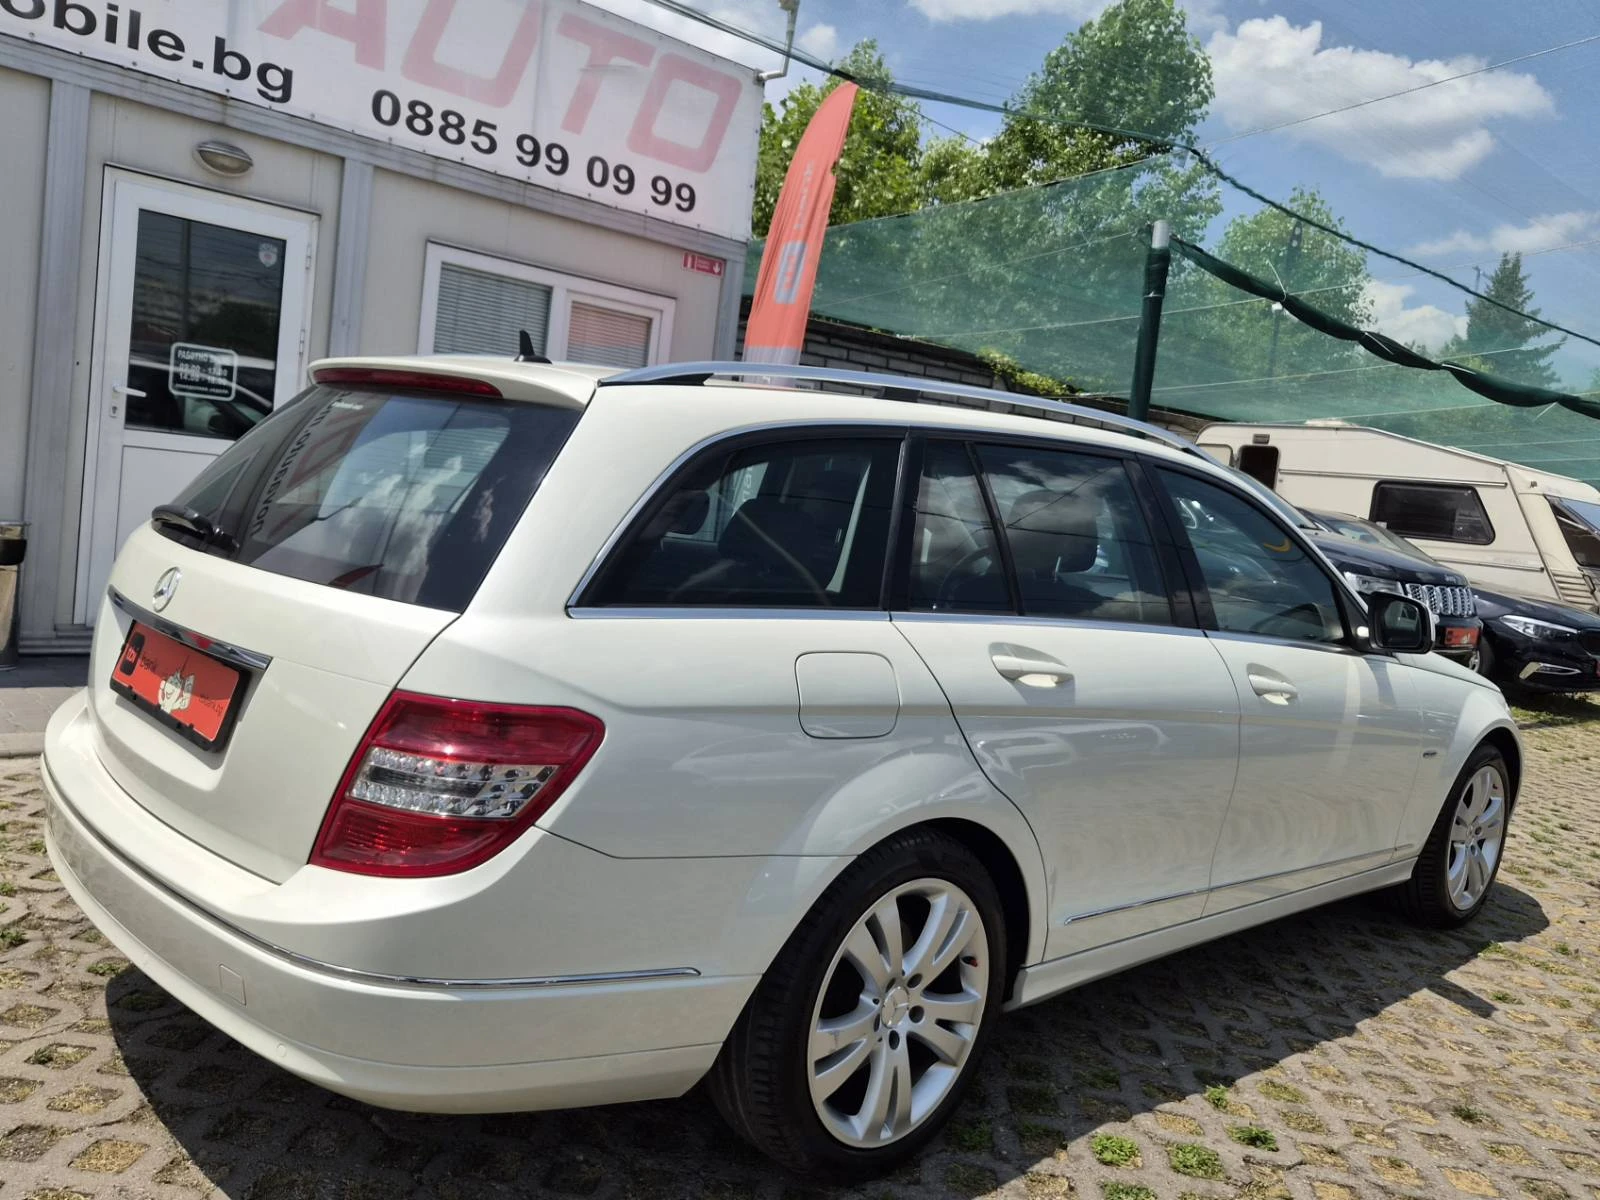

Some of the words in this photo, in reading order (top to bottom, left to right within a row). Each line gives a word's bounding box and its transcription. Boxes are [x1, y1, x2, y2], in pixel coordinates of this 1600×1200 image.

[371, 89, 498, 156] 0885
[515, 133, 570, 176] 99
[586, 155, 636, 196] 09
[650, 175, 697, 213] 99
